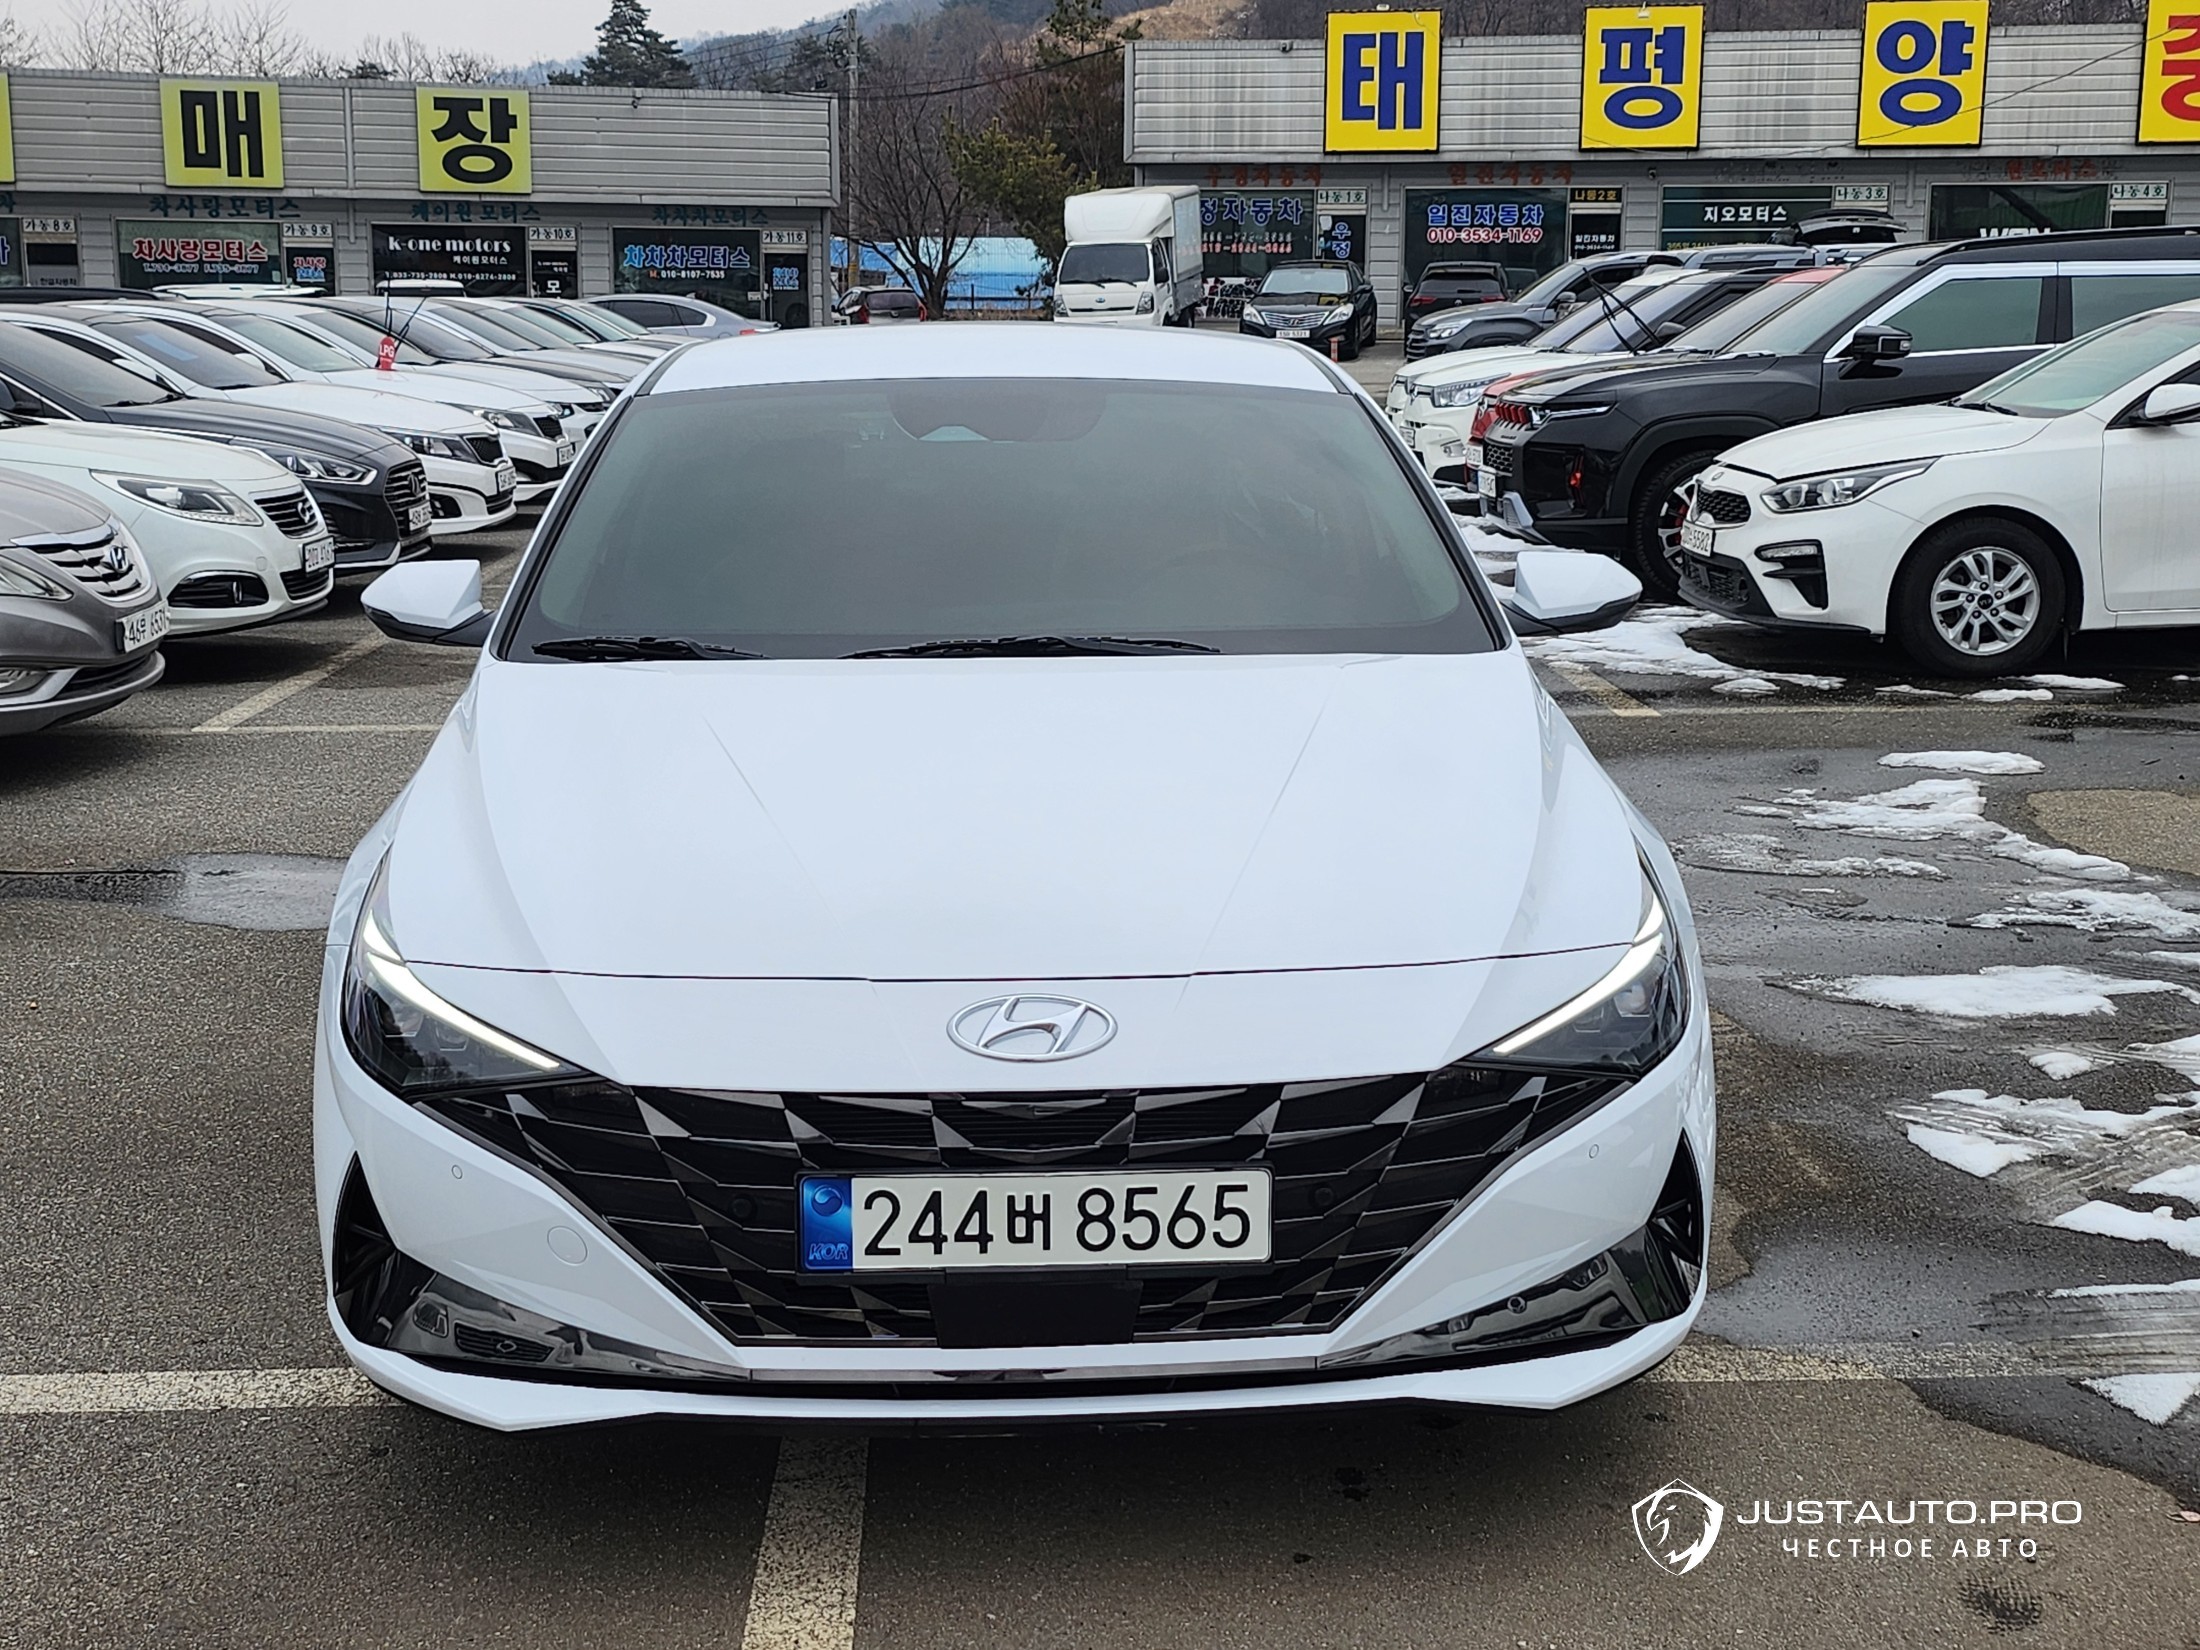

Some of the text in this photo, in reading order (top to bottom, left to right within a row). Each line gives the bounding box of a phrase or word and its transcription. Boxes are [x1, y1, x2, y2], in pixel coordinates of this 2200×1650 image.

[1342, 19, 1974, 130] 태 평 양
[180, 90, 518, 183] 매 장
[1427, 204, 1545, 226] 일진자동차
[1704, 205, 1787, 223] 지오모터스
[388, 236, 511, 253] k-one motors
[1427, 227, 1544, 244] 010-3534-1169
[133, 237, 269, 263] 차사랑모터스
[623, 244, 751, 269] 차차차모터스
[380, 344, 395, 358] LPG
[863, 1184, 1251, 1257] 244버 8565
[808, 1243, 849, 1261] KOR
